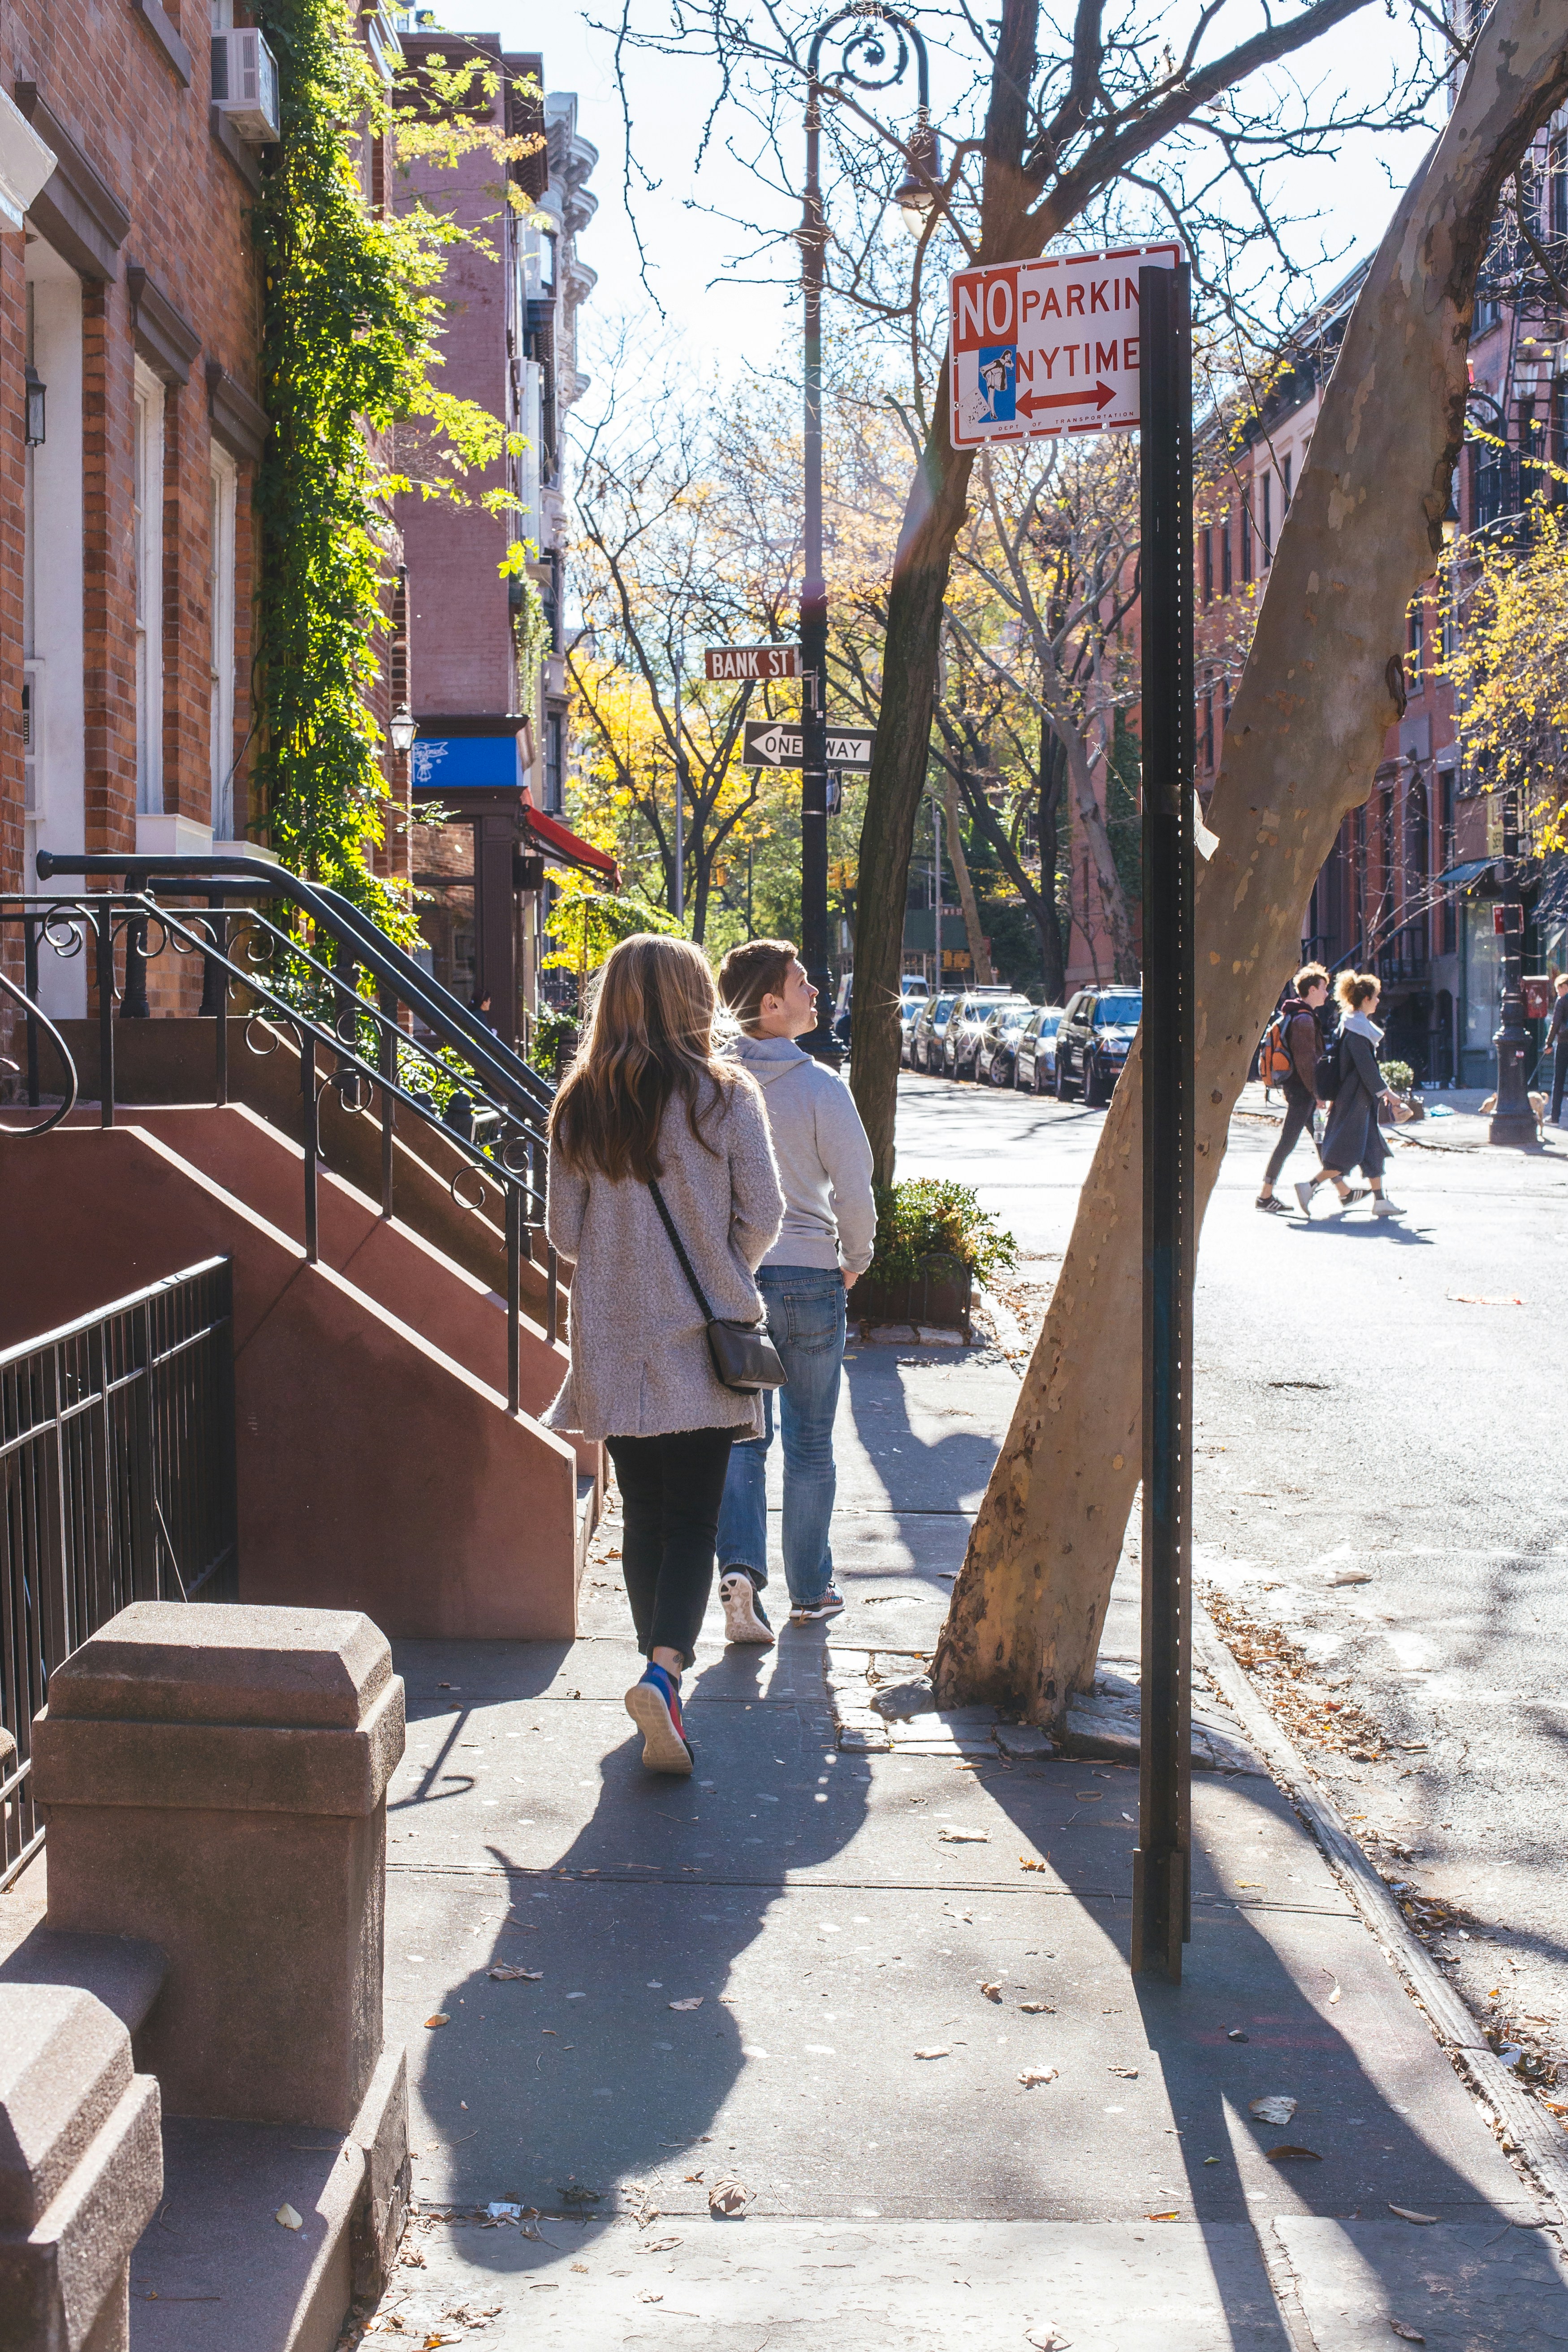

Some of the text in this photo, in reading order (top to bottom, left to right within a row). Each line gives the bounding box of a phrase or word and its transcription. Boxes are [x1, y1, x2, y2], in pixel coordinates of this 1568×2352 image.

[959, 277, 1140, 340] NO PARKIN
[1016, 337, 1140, 383] NYTIME
[1055, 411, 1134, 424] TRANSPORTATION
[712, 650, 789, 678] BANK ST
[765, 736, 862, 758] ONE WAY
